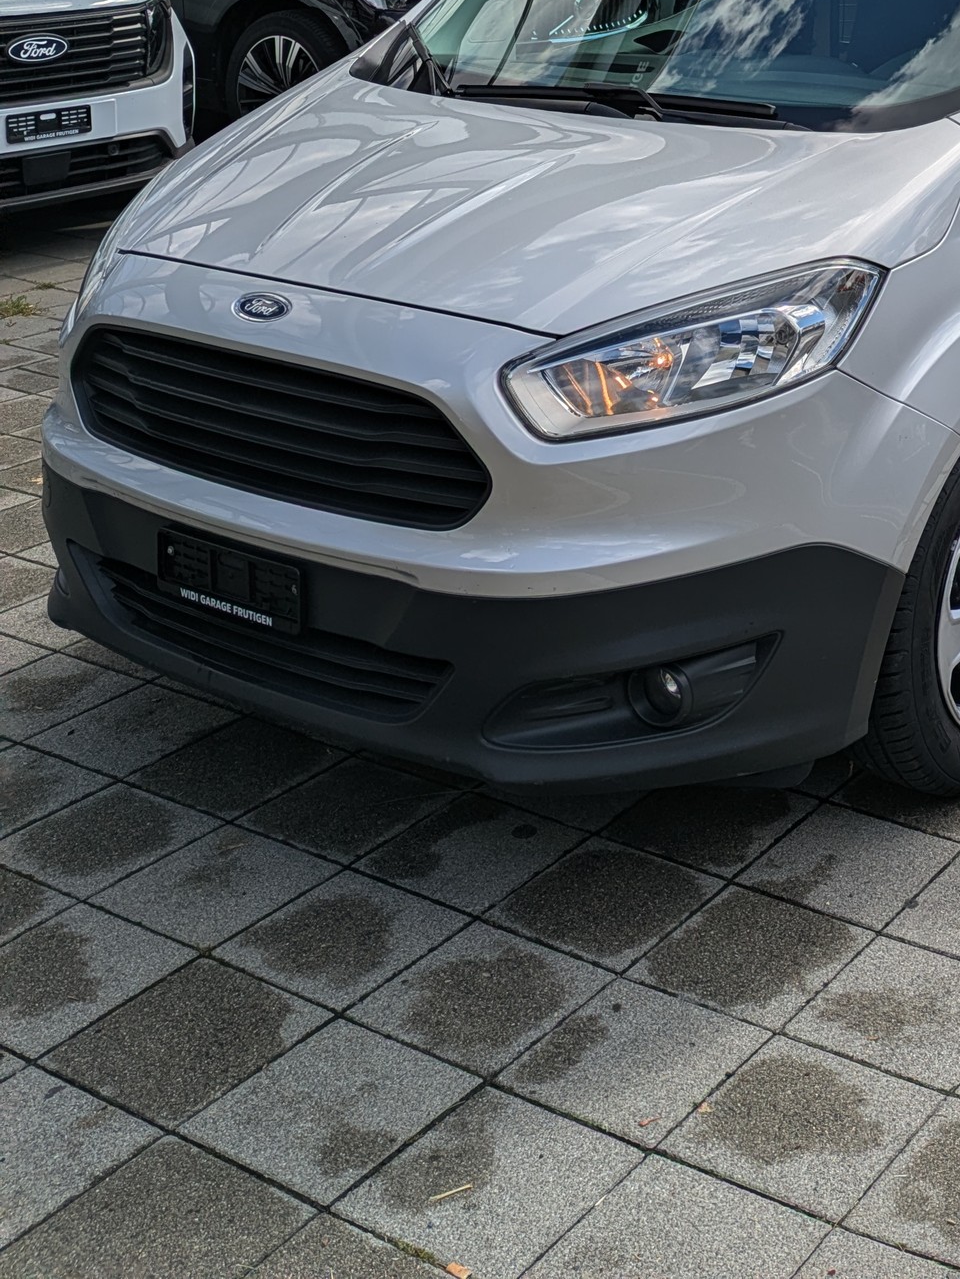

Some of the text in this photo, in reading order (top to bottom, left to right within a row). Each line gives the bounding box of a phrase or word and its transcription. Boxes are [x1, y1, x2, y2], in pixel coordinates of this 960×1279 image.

[20, 40, 57, 58] Ford
[36, 132, 56, 140] GARAGE
[56, 129, 79, 137] FRUTIGEN
[244, 297, 279, 316] Ford
[180, 587, 273, 627] WIDI GARAGE FRUTIGEN
